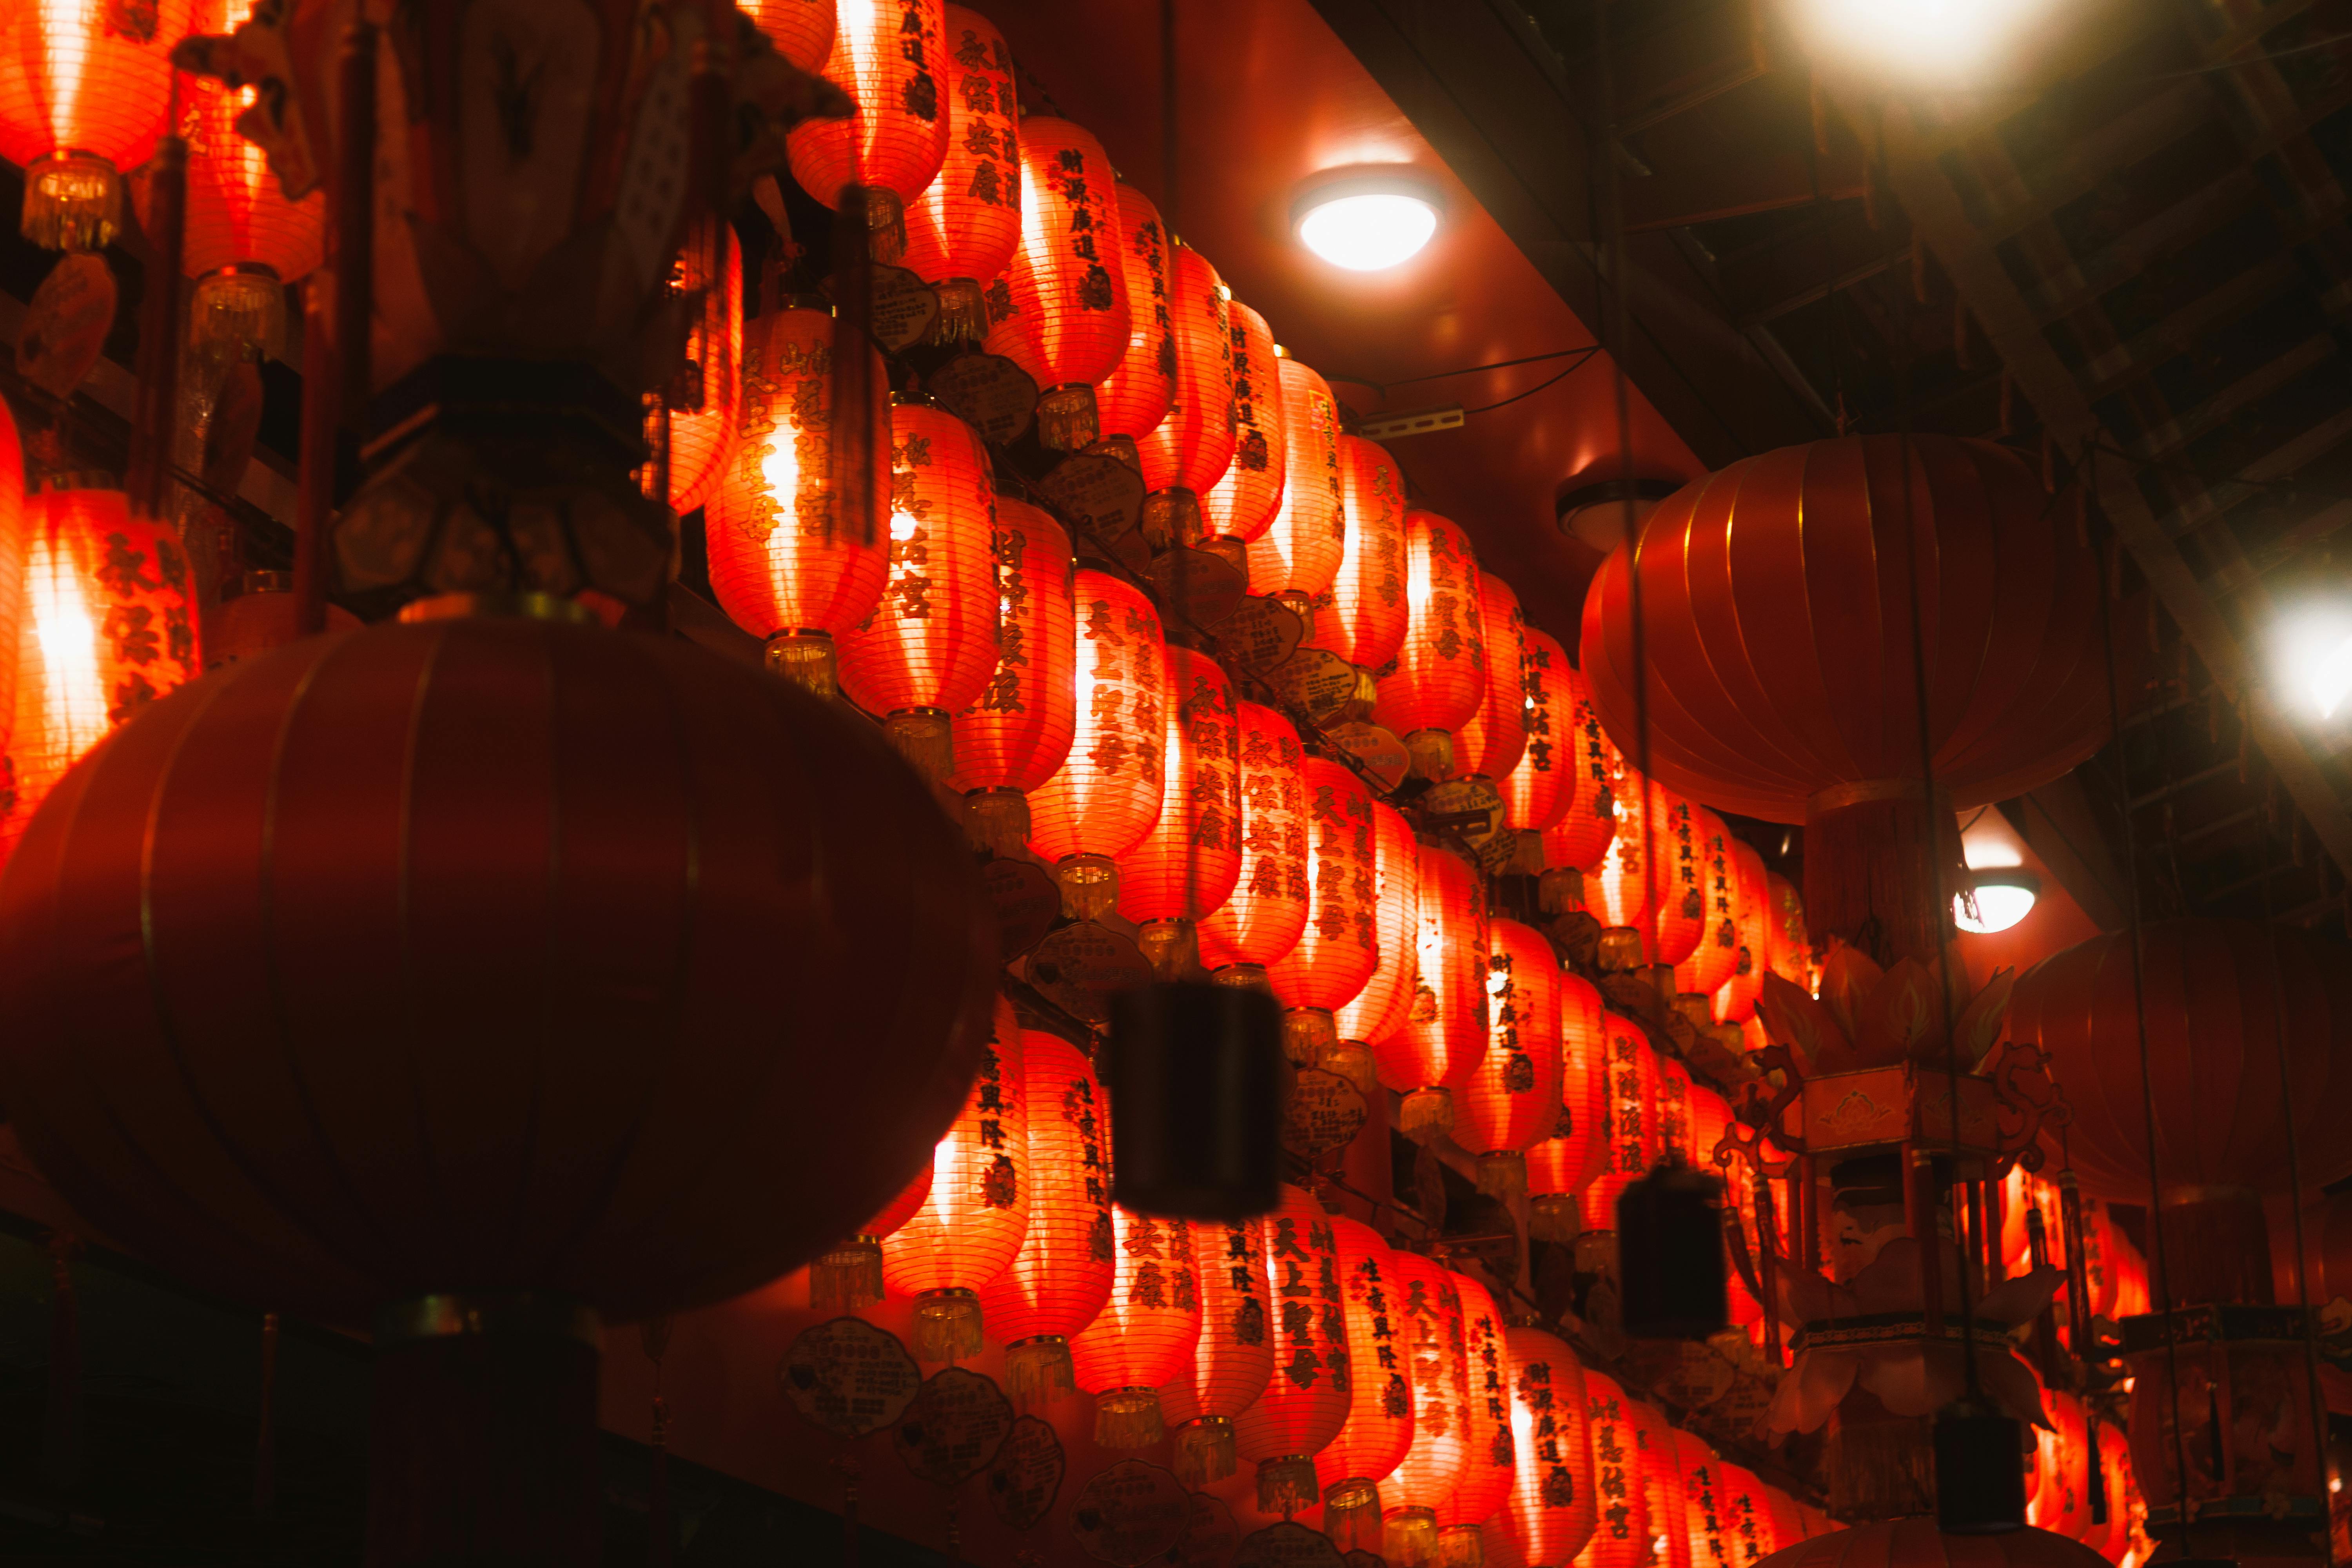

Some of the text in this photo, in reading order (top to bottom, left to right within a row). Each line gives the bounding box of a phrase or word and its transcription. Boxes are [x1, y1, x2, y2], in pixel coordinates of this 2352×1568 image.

[955, 30, 1002, 205] 永保安康
[1058, 148, 1099, 262] 財源廣進
[1231, 326, 1258, 426] 財源廣進
[1373, 465, 1400, 608] 天上聖母
[1429, 528, 1464, 661] 天上聖母
[1085, 600, 1130, 776] 天上聖母
[1185, 675, 1224, 851] 永保安康
[1242, 731, 1280, 898] 永保安康
[1312, 785, 1349, 941] 天上聖母
[1273, 1218, 1321, 1390] 天上聖母
[1362, 1256, 1397, 1370] 生意興隆
[1406, 1280, 1448, 1437] 天上聖母
[1524, 1362, 1563, 1463] 財源廣進
